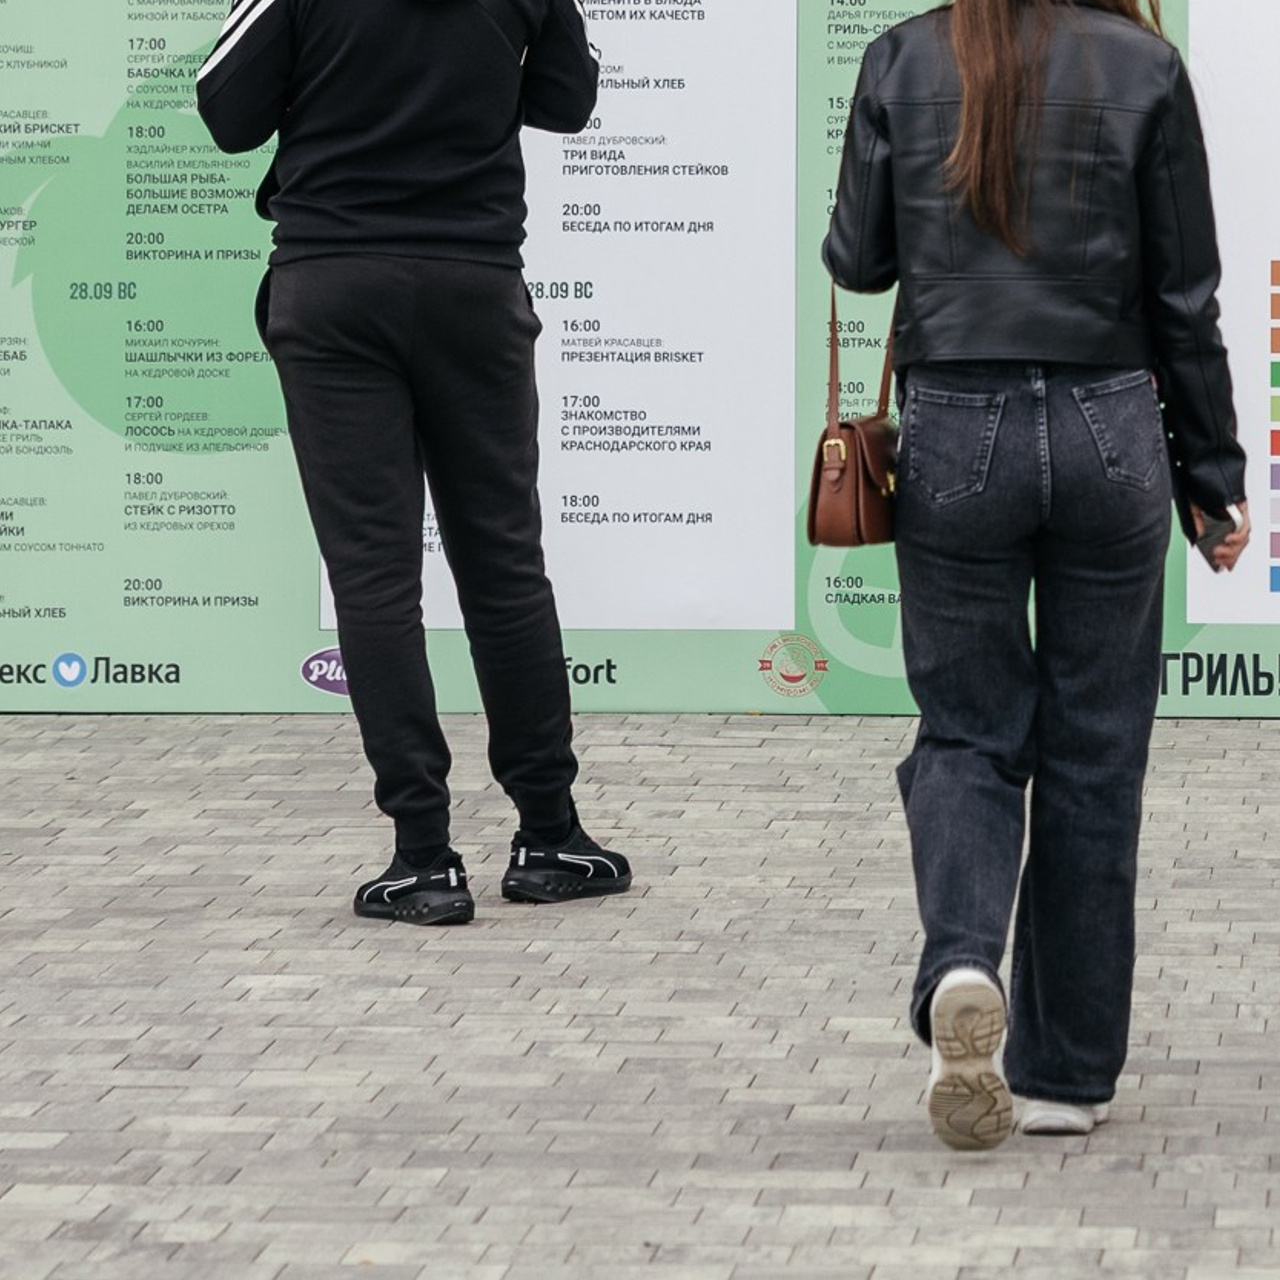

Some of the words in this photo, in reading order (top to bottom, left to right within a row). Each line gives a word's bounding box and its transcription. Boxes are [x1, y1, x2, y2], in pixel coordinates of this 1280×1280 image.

[70, 282, 113, 300] 28.09
[117, 282, 136, 300] ВС
[561, 351, 651, 364] ПРЕЗЕНТАЦИЯ
[654, 351, 704, 362] BRISKET
[561, 440, 677, 453] КРАСНОДАРСКОГО
[680, 440, 711, 451] КРАЯ
[124, 596, 199, 607] ВИКТОРИНА
[202, 596, 211, 606] И
[214, 596, 258, 607] ПРИЗЫ
[91, 657, 180, 683] Лавка
